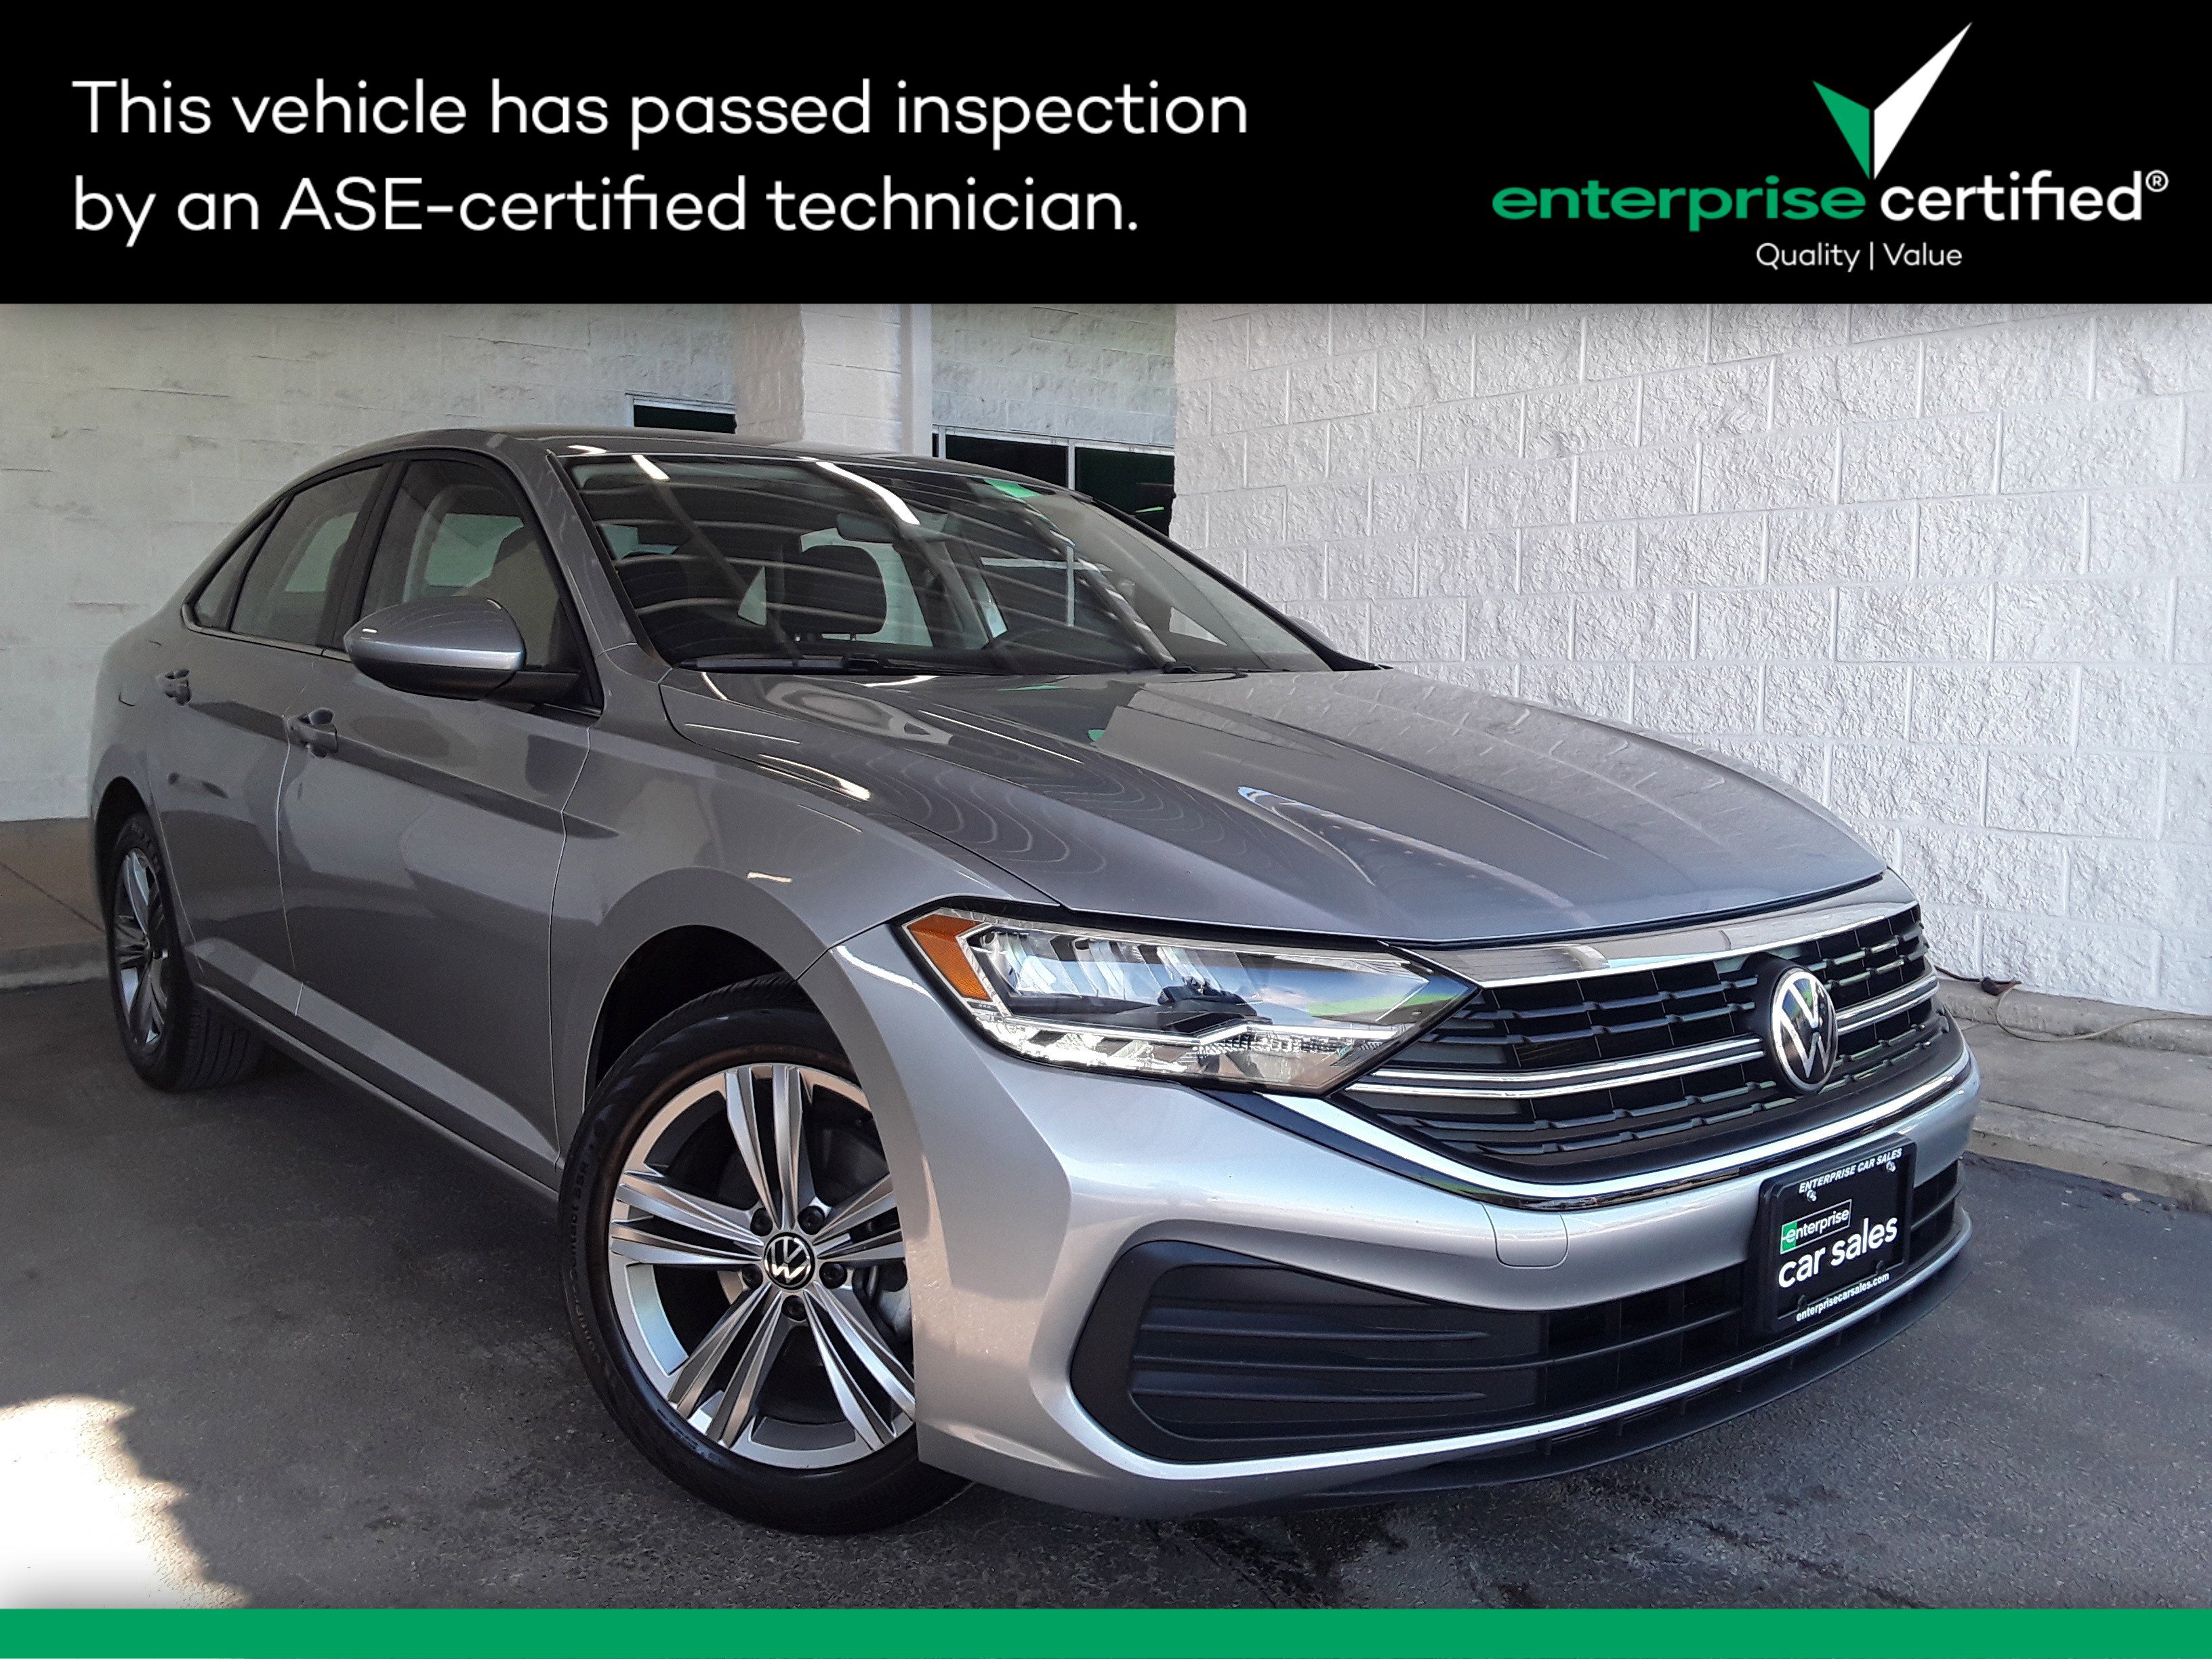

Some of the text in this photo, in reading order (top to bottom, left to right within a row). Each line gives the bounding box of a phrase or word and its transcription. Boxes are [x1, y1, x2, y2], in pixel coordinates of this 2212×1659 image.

[1799, 1148, 1902, 1193] ENTERPRISE CAR SALES
[1782, 1209, 1849, 1243] enterprise
[1778, 1217, 1898, 1288] car sales
[1796, 1273, 1889, 1322] enterprisecarsales.com
